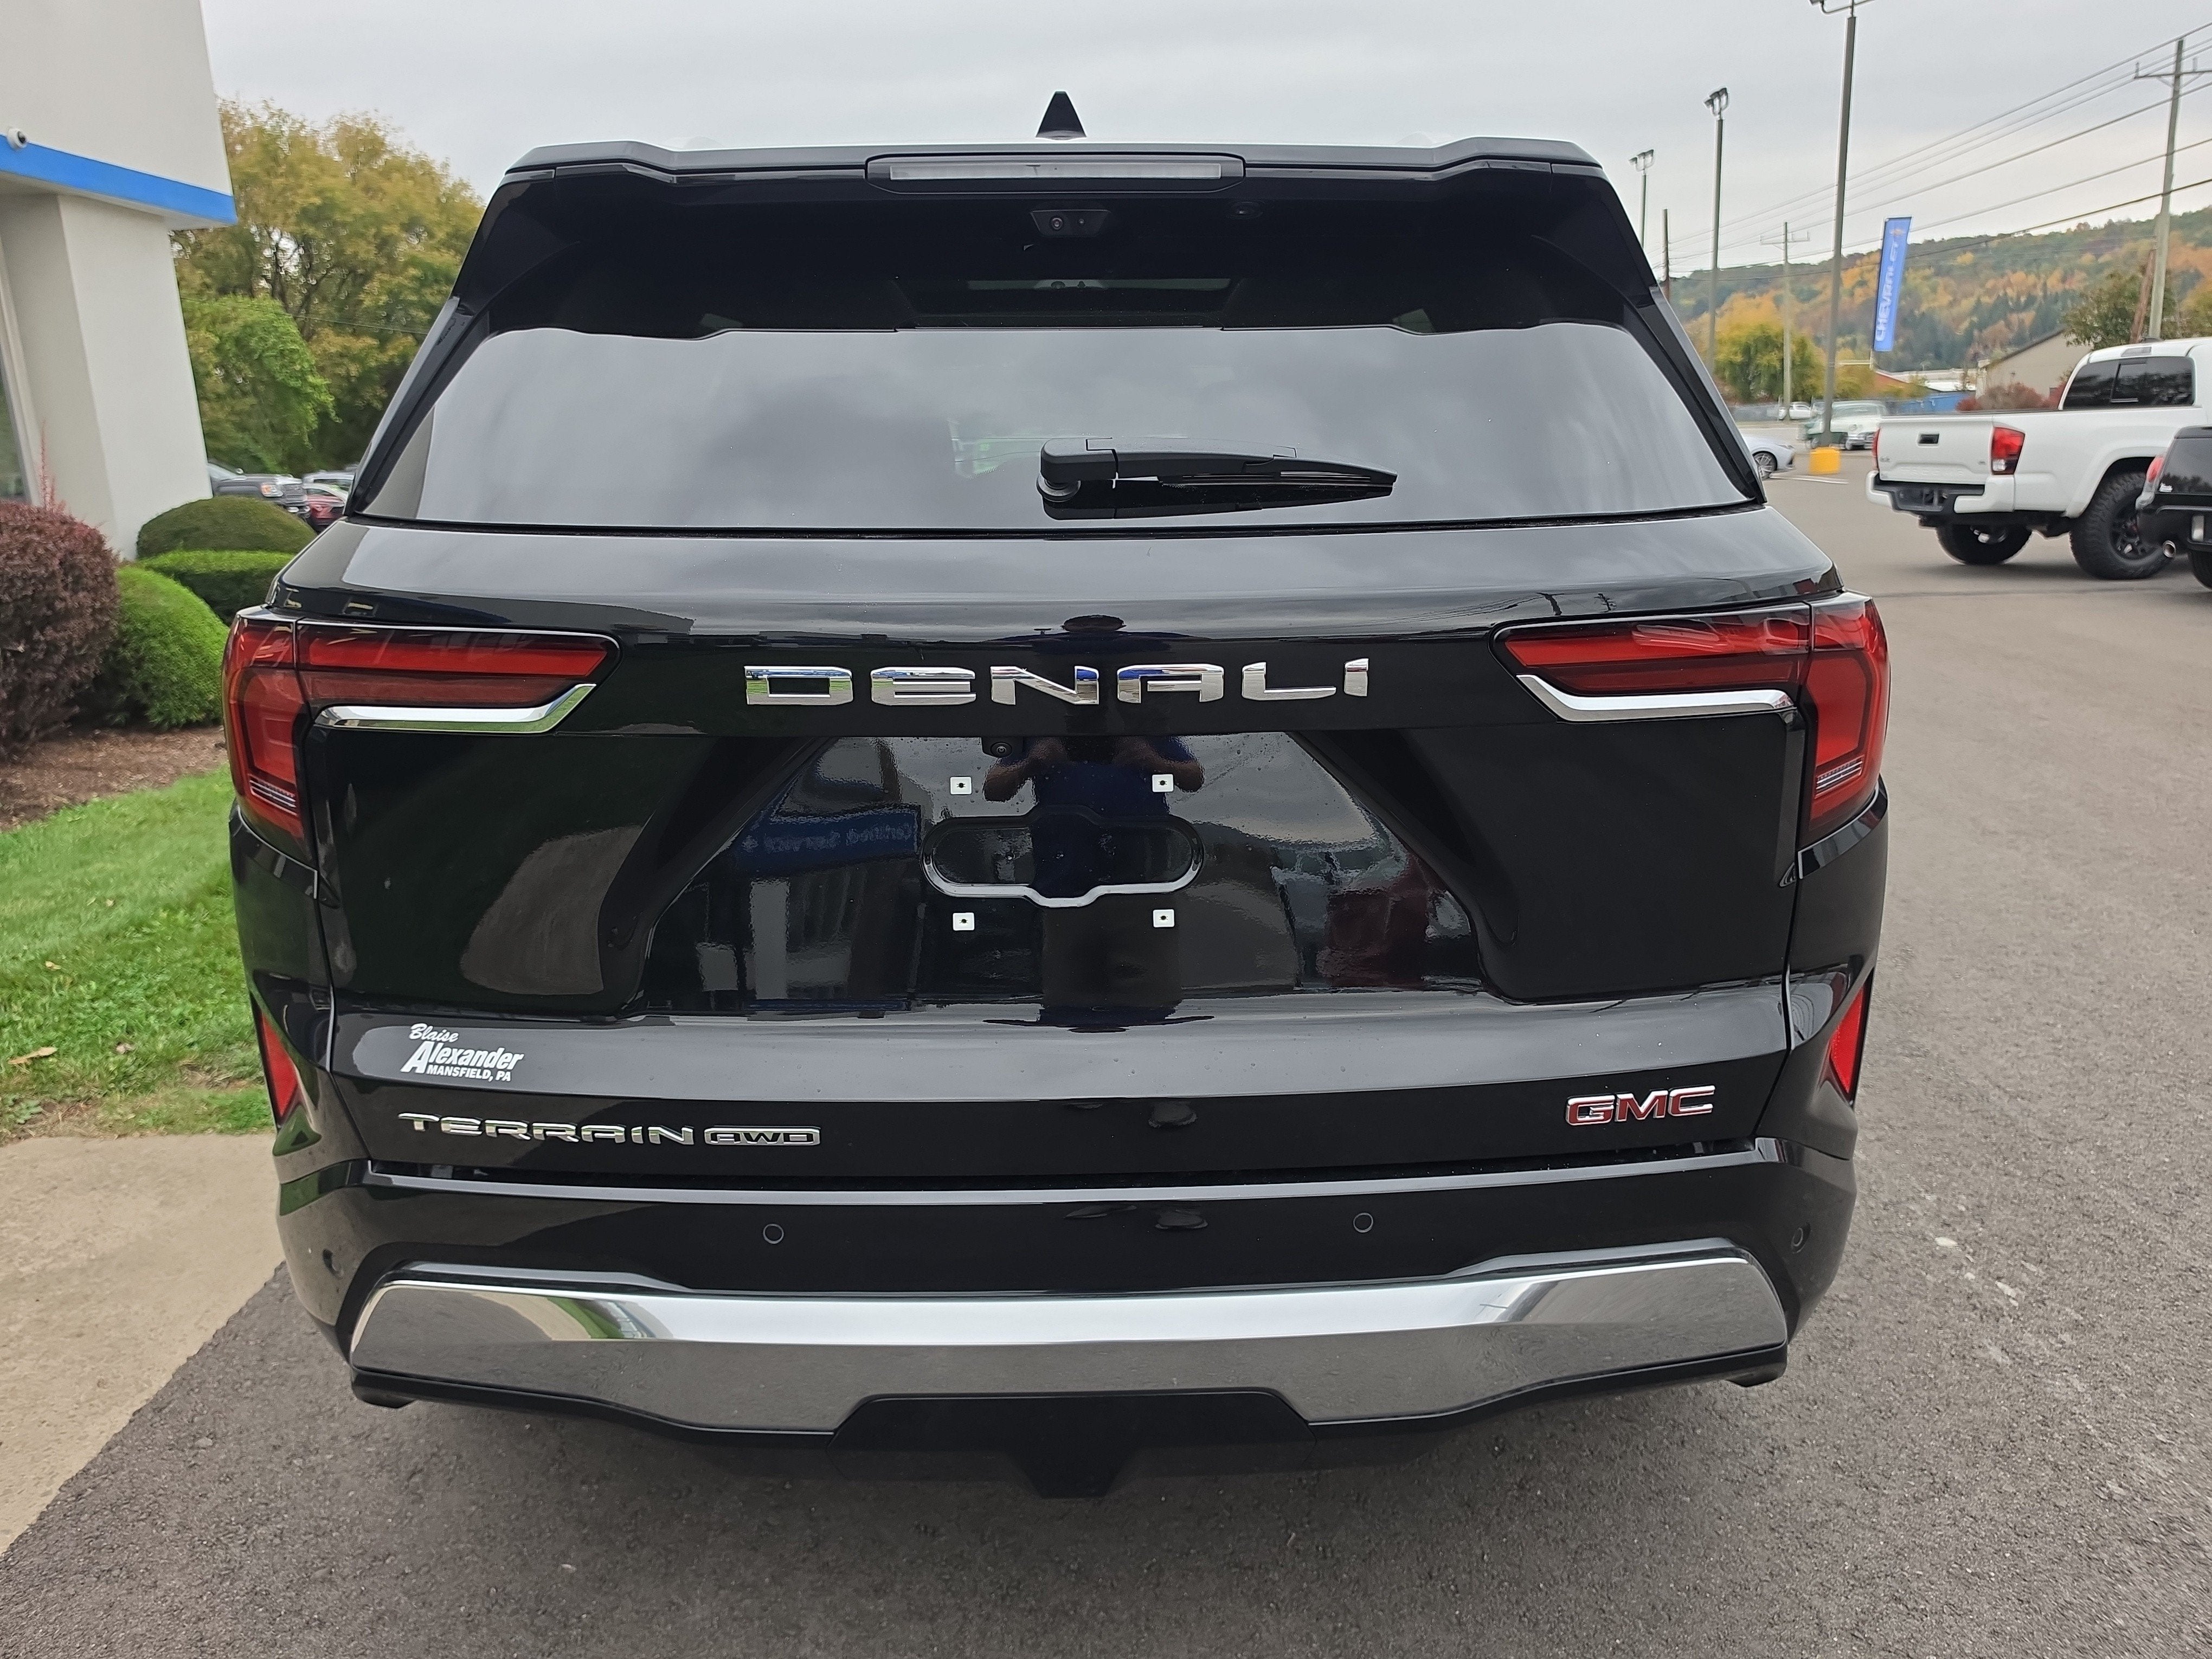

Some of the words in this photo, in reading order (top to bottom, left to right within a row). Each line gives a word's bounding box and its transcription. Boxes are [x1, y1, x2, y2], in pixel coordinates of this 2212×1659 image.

[1875, 240, 1899, 342] CHEVROLET
[744, 658, 1369, 705] DENALI
[409, 1023, 459, 1043] Blaise
[400, 1041, 524, 1073] Alexander
[426, 1065, 493, 1082] MANSFIELD,
[495, 1071, 511, 1082] PA
[1565, 1085, 1715, 1126] GMC
[398, 1113, 694, 1146] TERRAIN
[706, 1127, 819, 1145] AWD
